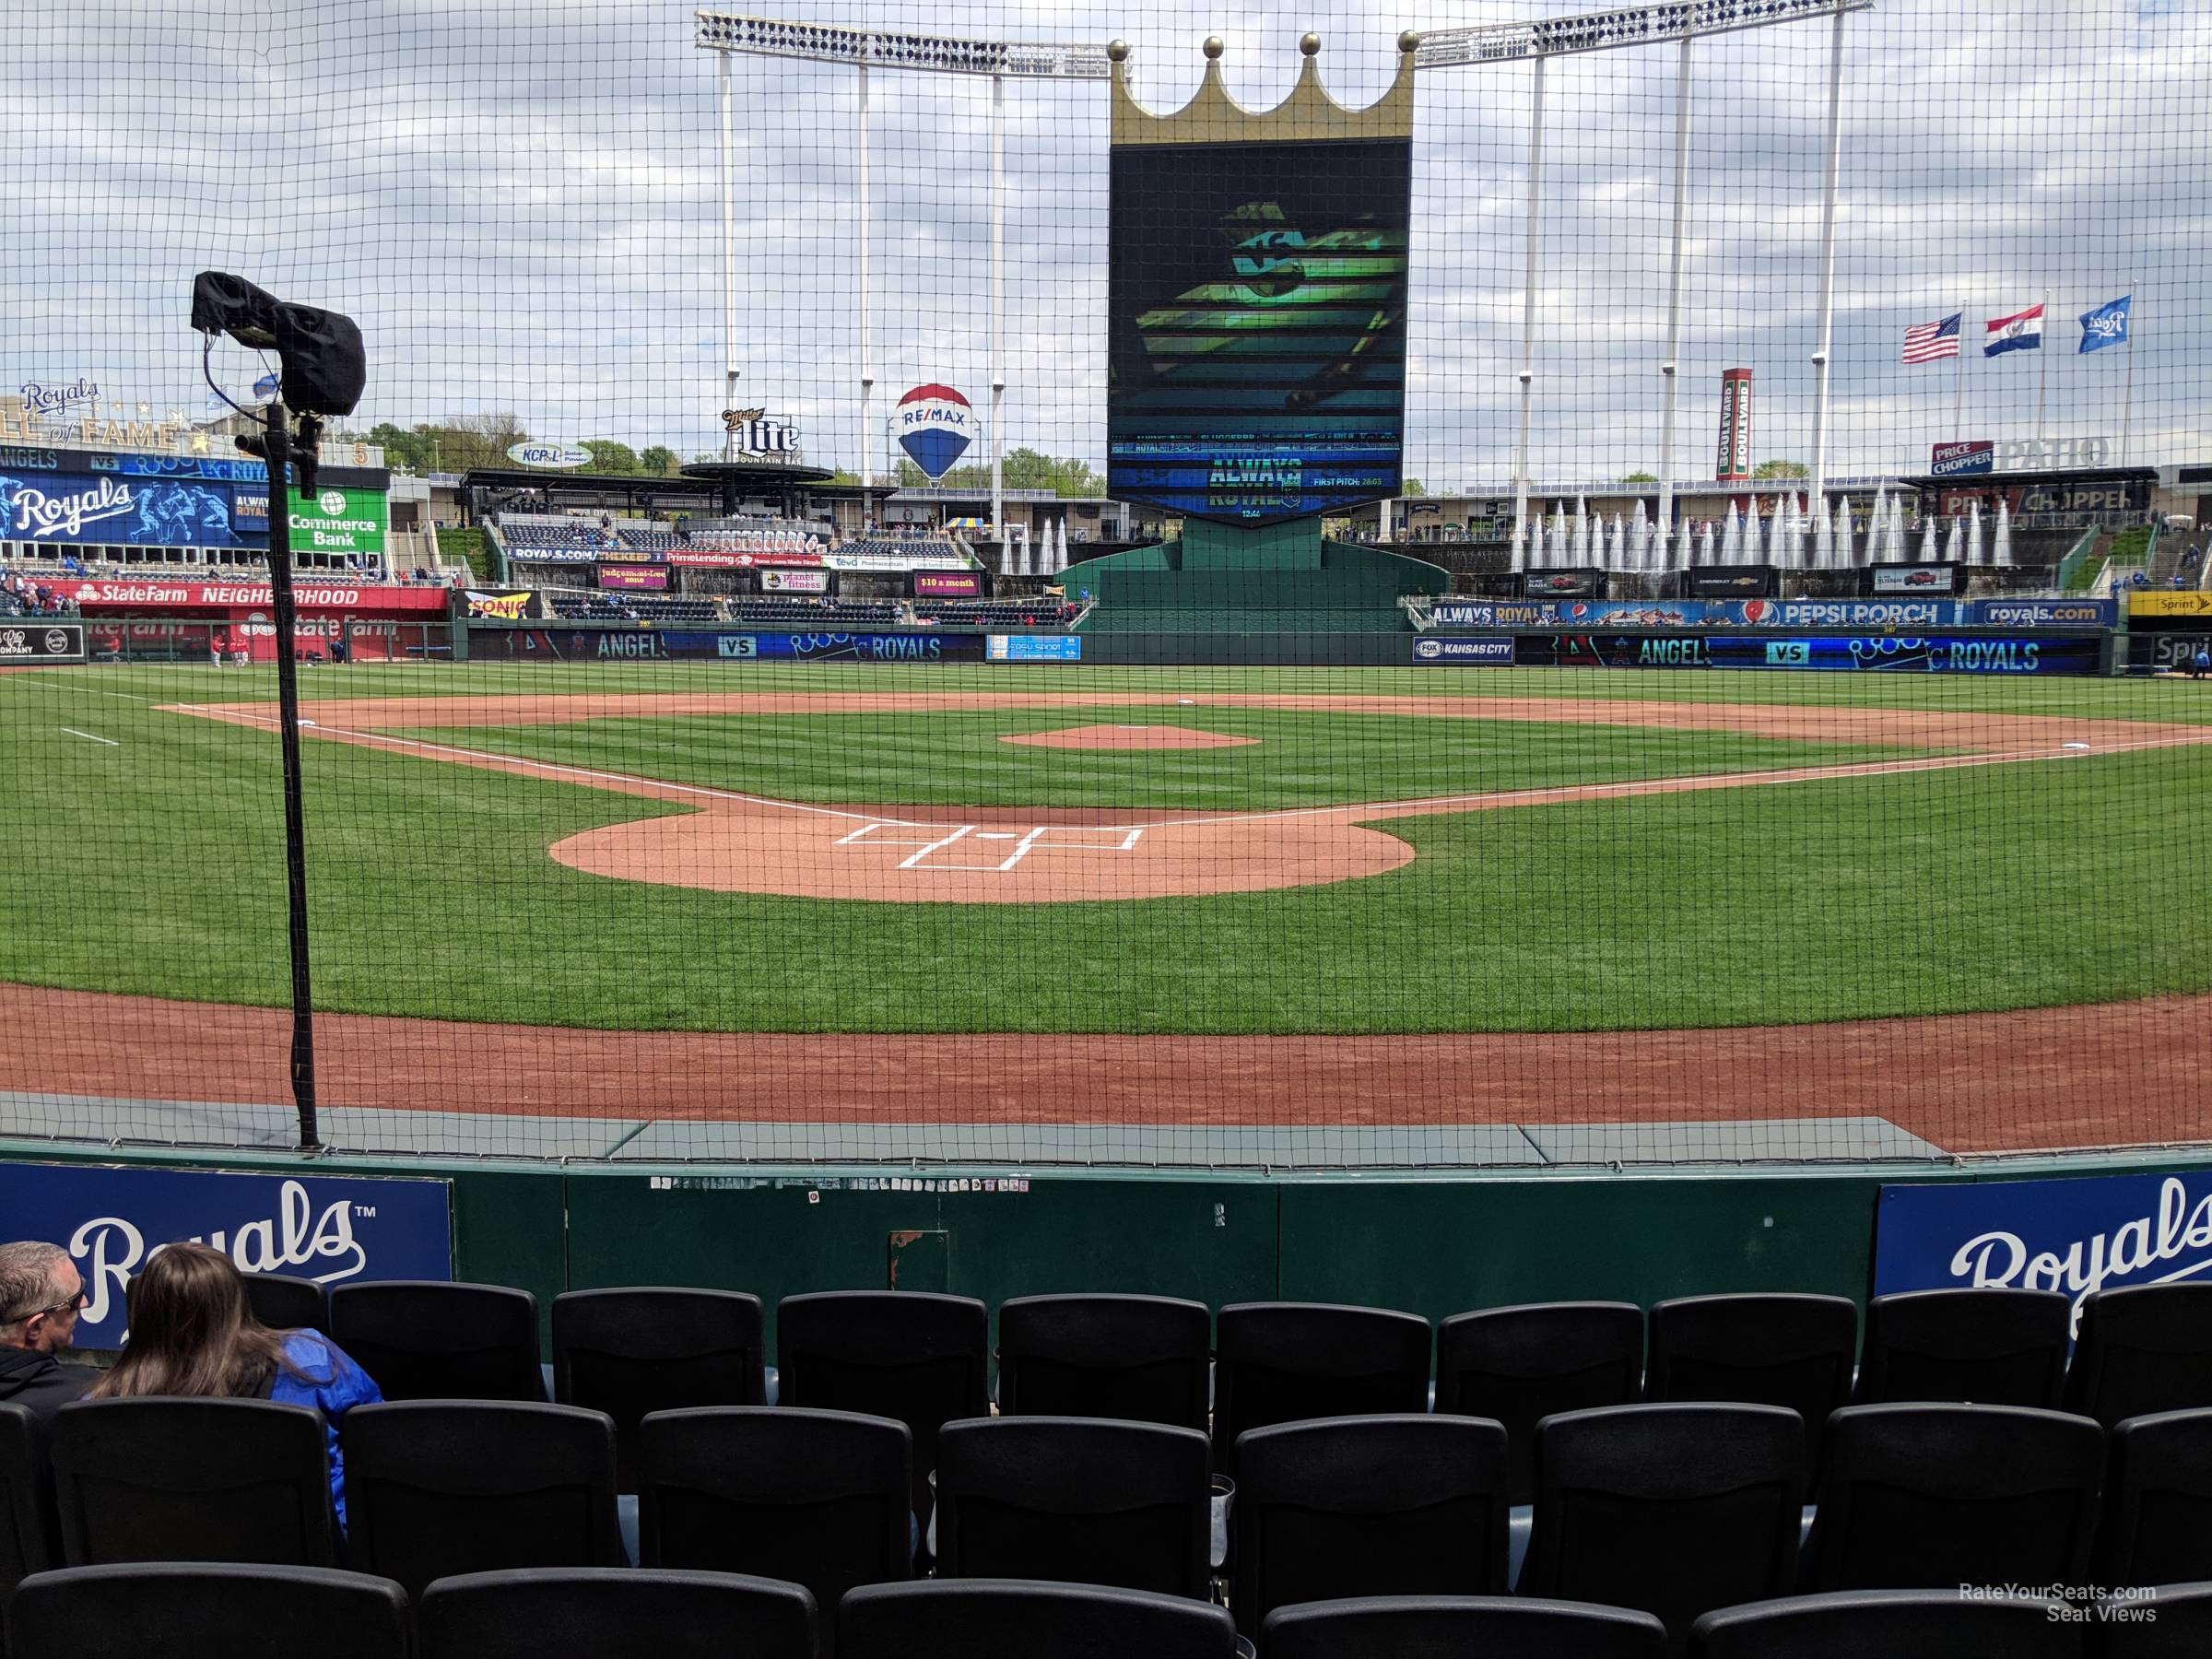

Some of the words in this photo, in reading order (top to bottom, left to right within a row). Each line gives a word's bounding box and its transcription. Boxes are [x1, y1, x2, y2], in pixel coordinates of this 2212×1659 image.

[20, 378, 101, 415] Royals
[723, 408, 764, 430] Miller
[904, 408, 965, 427] RE/MAX
[50, 421, 77, 449] of
[81, 418, 179, 450] FAME
[1719, 387, 1732, 466] BOULEVARD
[1736, 387, 1748, 466] BOULEVARD
[738, 419, 799, 458] Lite
[100, 454, 115, 468] VS
[353, 442, 369, 465] 5
[523, 448, 559, 463] KCP&L
[1936, 444, 1971, 461] PRICE
[1994, 437, 2109, 471] PATIO
[1933, 452, 1992, 474] CHOPPER
[231, 463, 292, 484] ROYAS
[1313, 477, 1335, 486] FIRST
[1336, 477, 1360, 486] PITCH:
[14, 477, 135, 537] Royals
[237, 496, 268, 507] ALWAY
[288, 514, 377, 532] Commerce
[313, 531, 356, 547] Bank
[861, 559, 904, 568] Pharmaceuticals
[783, 572, 815, 582] planet
[788, 579, 822, 589] fitness
[921, 578, 937, 587] $10
[945, 578, 975, 587] month
[473, 599, 525, 613] SONIC
[2161, 599, 2194, 610] Sprint
[1433, 607, 1492, 623] ALWAYS
[1784, 604, 1835, 623] PEPSI
[1853, 605, 1937, 624] PORCH
[1989, 606, 2097, 623] royals.com
[725, 638, 749, 654] VS
[872, 636, 941, 660] ROYALS
[1443, 643, 1488, 654] KANSAS
[1487, 643, 1512, 654] CITY
[1775, 643, 1803, 662] VS
[1948, 641, 2040, 671] ROYALS
[355, 1206, 376, 1218] TM
